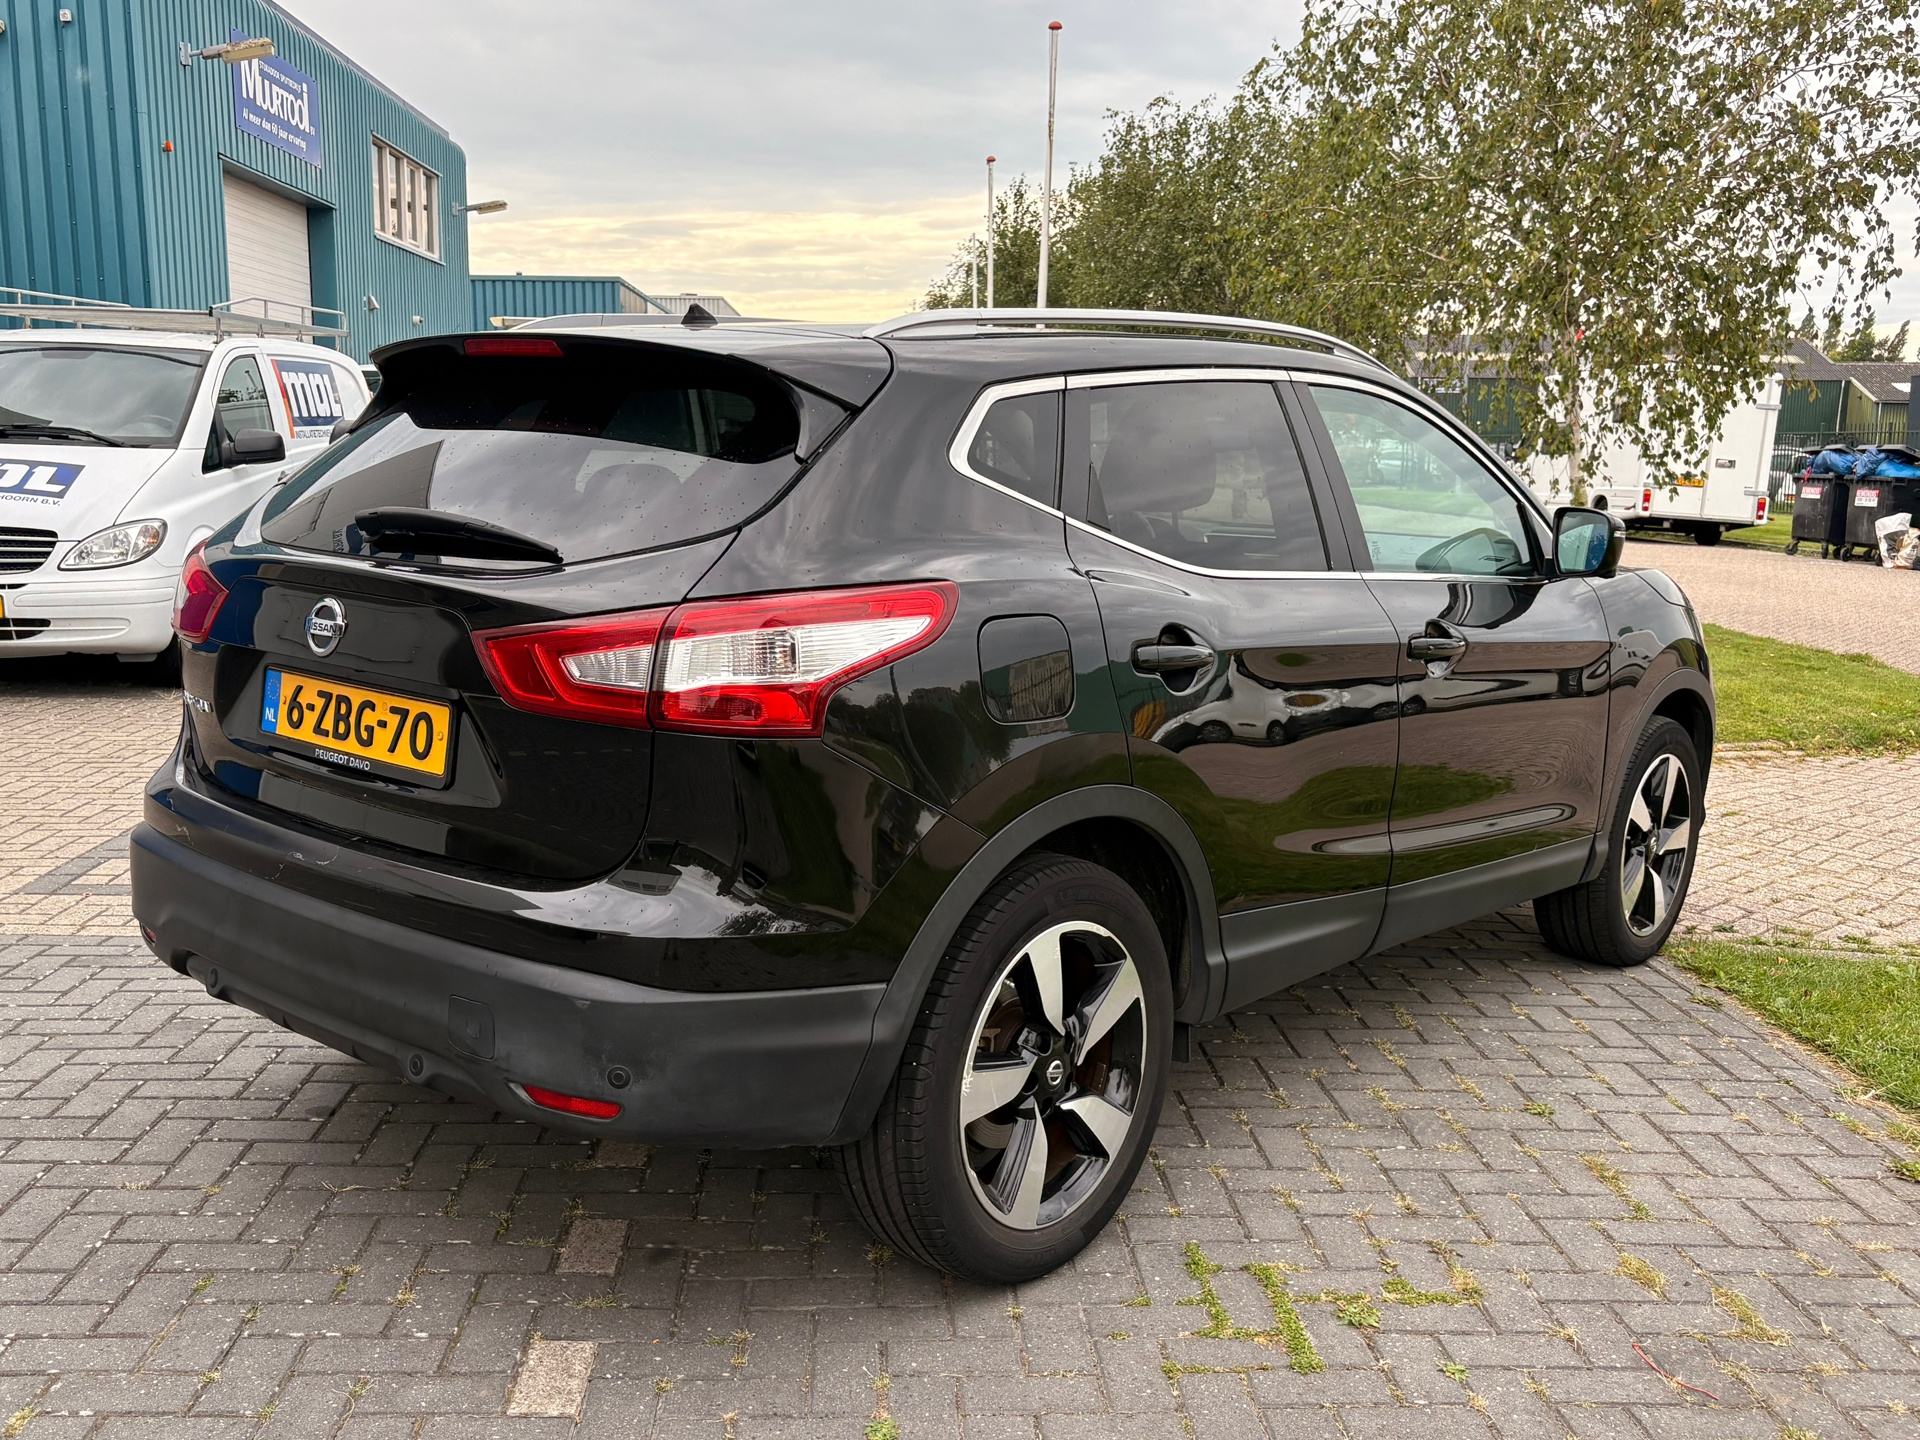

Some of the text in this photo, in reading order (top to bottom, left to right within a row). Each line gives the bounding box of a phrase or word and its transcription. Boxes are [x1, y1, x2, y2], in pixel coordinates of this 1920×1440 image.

[243, 107, 307, 152] Al meer dan 60 jaar ervaring
[41, 498, 61, 506] B.V.
[264, 706, 276, 722] NL
[286, 684, 434, 760] 6-ZBG-70
[314, 748, 371, 770] PEUGEOT DAVO
